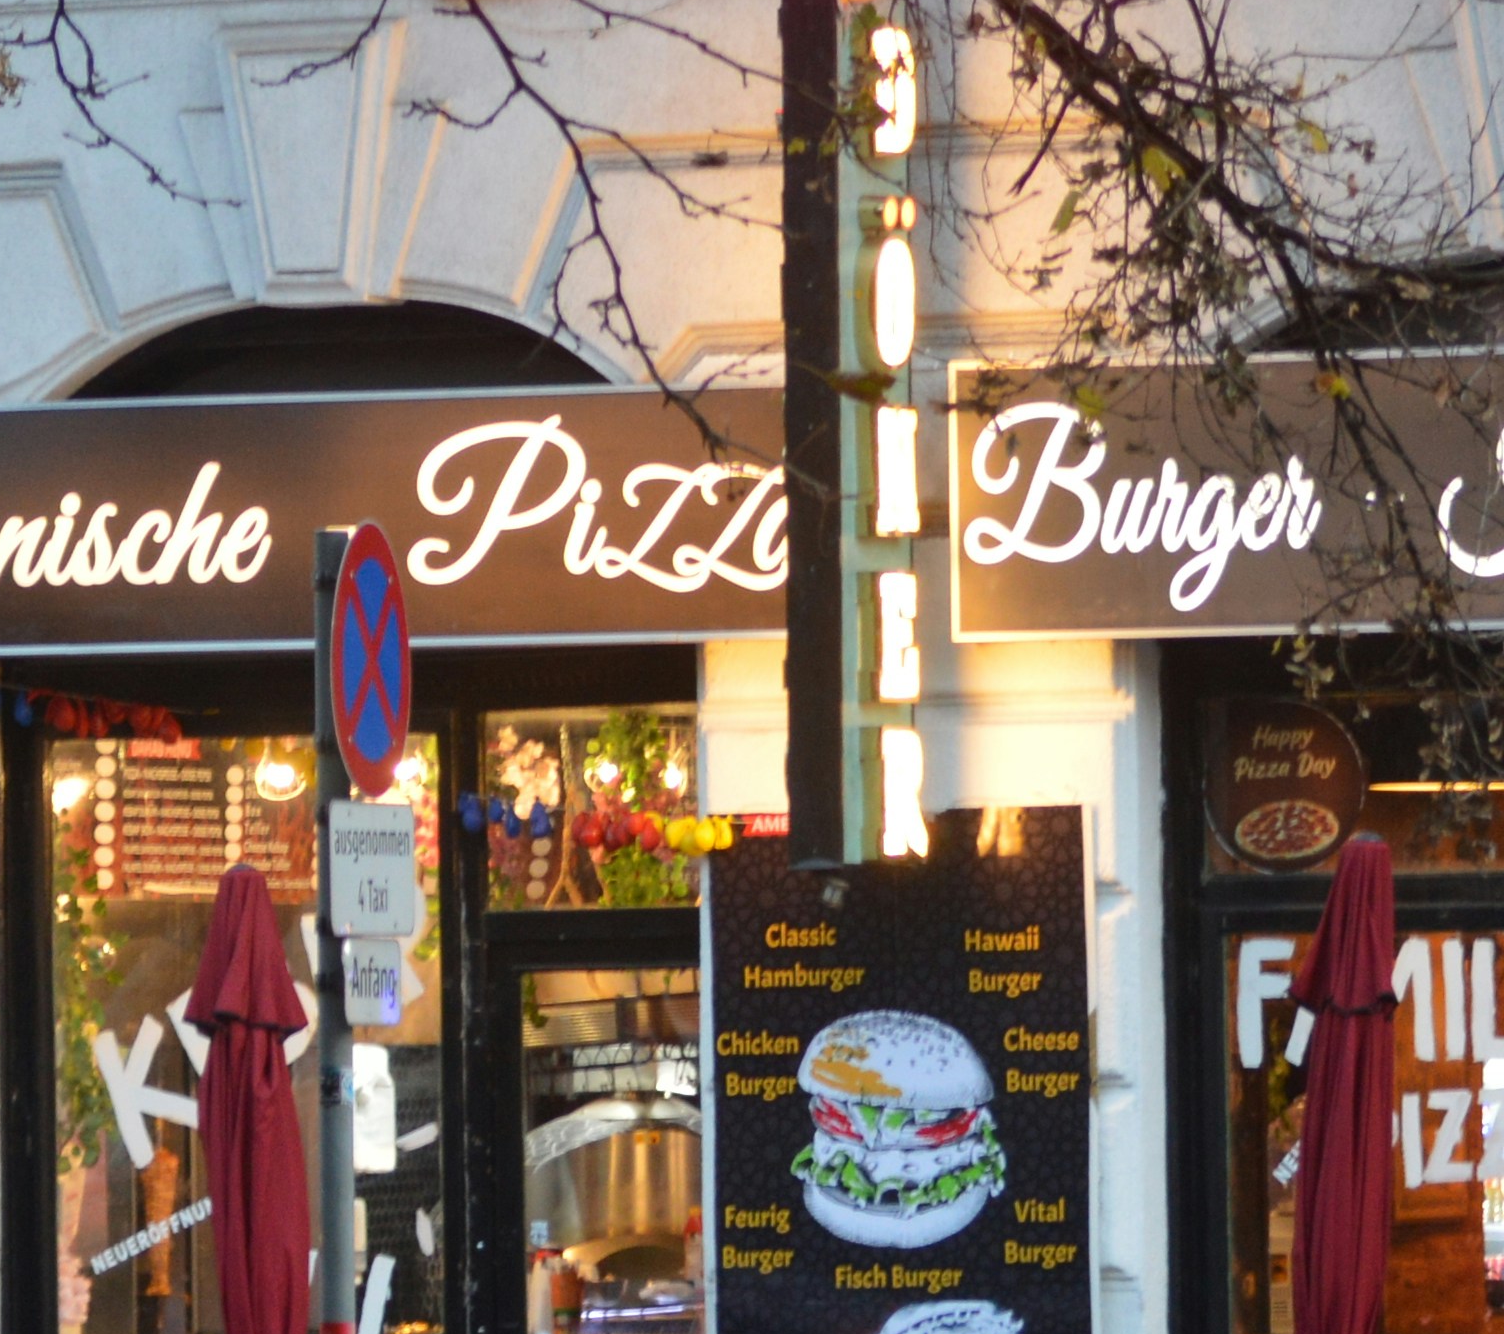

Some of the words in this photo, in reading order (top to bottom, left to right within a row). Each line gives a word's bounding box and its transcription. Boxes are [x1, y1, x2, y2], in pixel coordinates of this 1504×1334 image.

[965, 400, 1323, 611] Burger
[1251, 723, 1315, 752] Happy
[1233, 755, 1291, 783] Pizza
[1297, 751, 1336, 779] Day
[334, 827, 411, 858] ausgenommen
[357, 880, 368, 912] 4
[370, 880, 389, 912] Taxi
[765, 922, 838, 949] Classic
[964, 927, 1040, 952] Hawaii
[350, 965, 397, 1001] Anfang
[744, 964, 865, 993] Hamburger
[968, 969, 1042, 998] Burger
[717, 1031, 800, 1056] Chicken
[1003, 1027, 1080, 1052] Cheese
[725, 1073, 798, 1101] Burger
[1006, 1068, 1080, 1098] Burger
[724, 1205, 790, 1234] Feurig
[1014, 1198, 1066, 1223] Vital
[723, 1246, 793, 1273] Burger
[1004, 1240, 1077, 1269] Burger
[835, 1266, 887, 1289] Fisch
[892, 1266, 962, 1292] Burger
